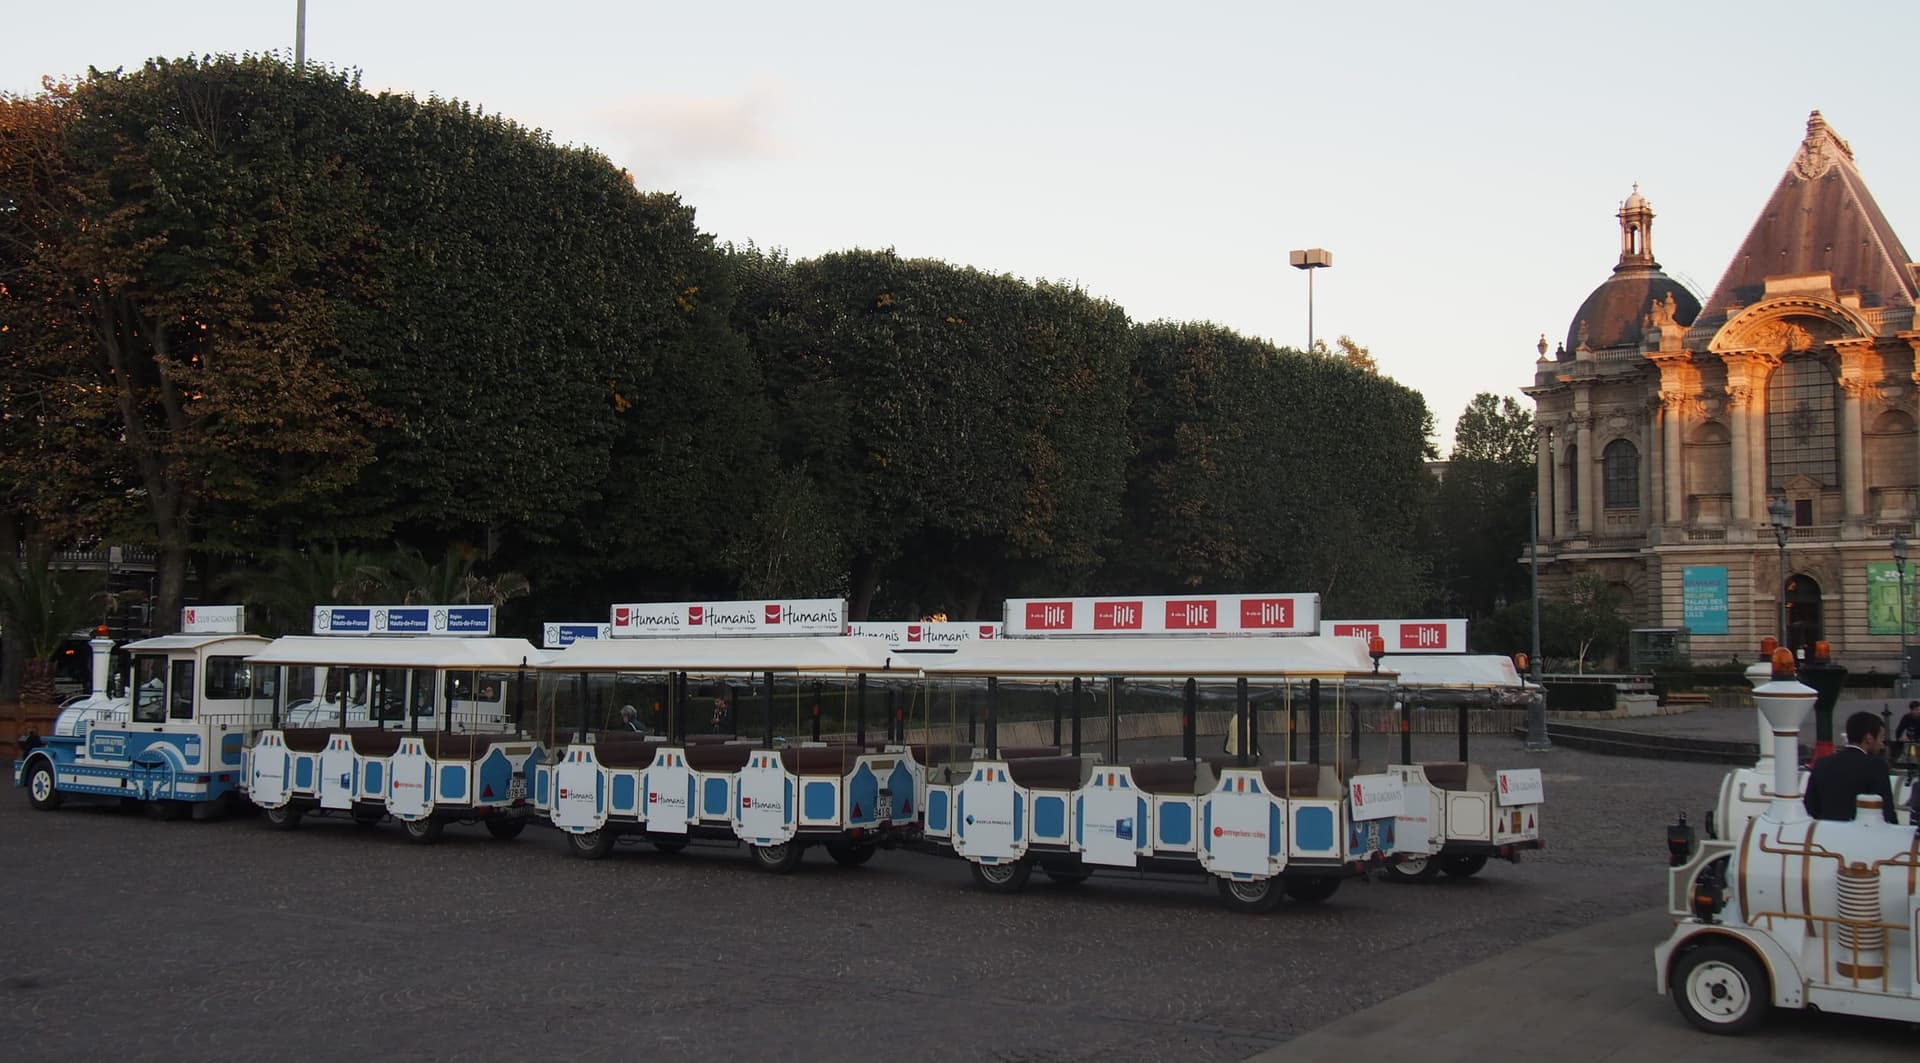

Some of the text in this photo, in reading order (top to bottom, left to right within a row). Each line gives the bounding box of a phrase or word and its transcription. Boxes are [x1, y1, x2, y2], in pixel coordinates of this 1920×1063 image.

[631, 608, 680, 627] Humanis
[705, 606, 756, 626] Humanis
[783, 605, 838, 625] Humanis
[568, 789, 594, 800] Humanis
[658, 793, 685, 804] Humanis
[752, 800, 781, 809] Humanis
